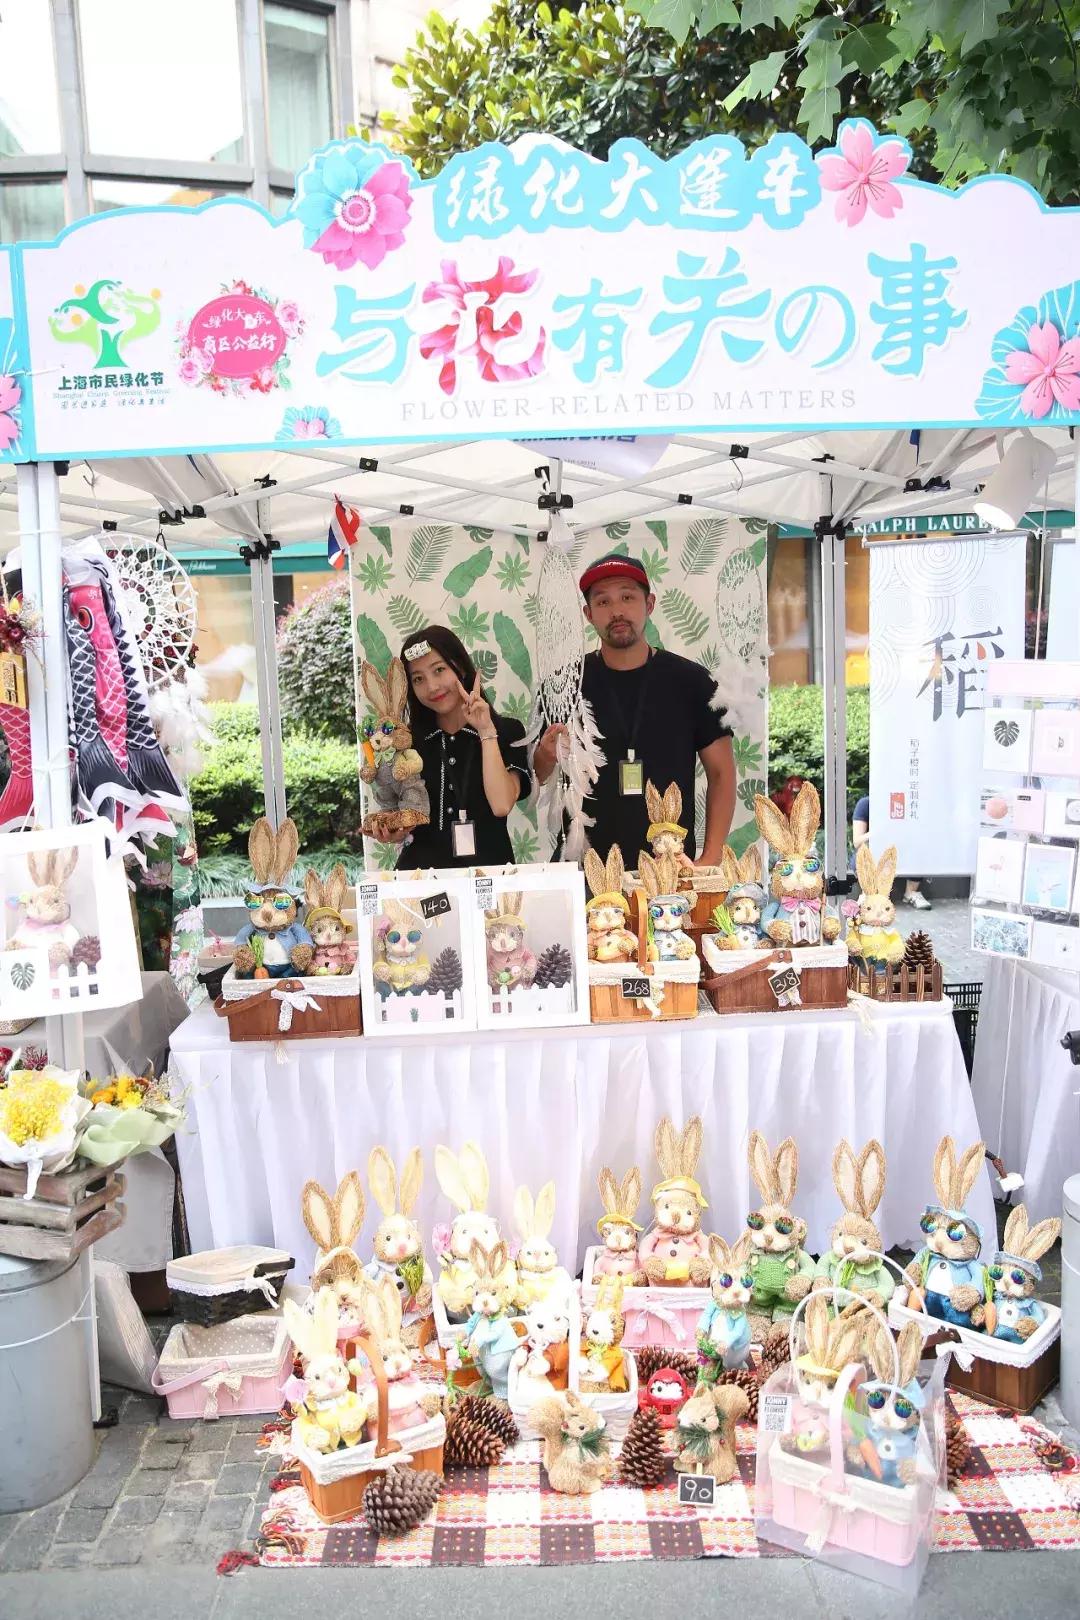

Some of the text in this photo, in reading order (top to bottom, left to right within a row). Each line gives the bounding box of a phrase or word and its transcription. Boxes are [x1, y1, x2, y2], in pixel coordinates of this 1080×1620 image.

[445, 146, 809, 228] 绿化大篷车
[316, 243, 968, 395] 与花有关の事
[58, 372, 164, 390] 上海市民绿化节
[401, 389, 857, 422] FLOWER-RELATED MATTERS
[424, 900, 448, 915] 140
[623, 980, 649, 995] 268
[774, 972, 796, 993] 318
[685, 1480, 711, 1500] 90
